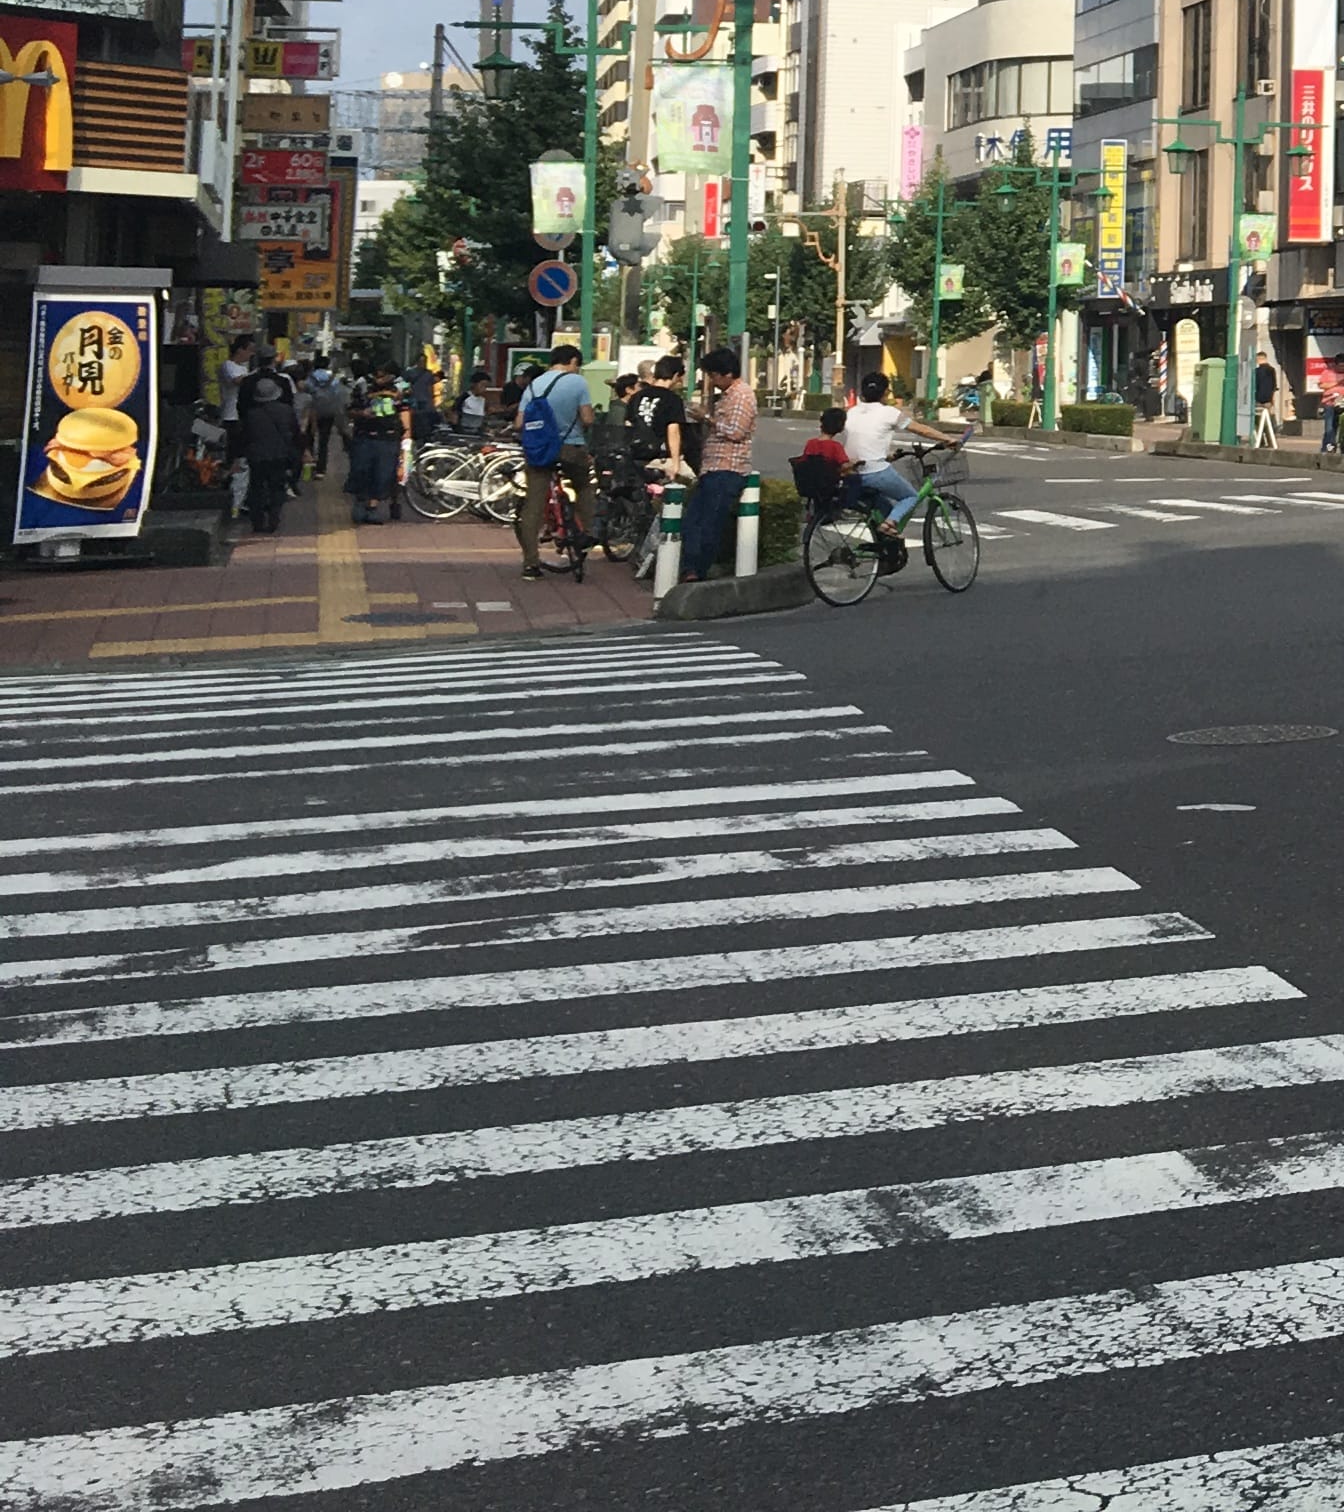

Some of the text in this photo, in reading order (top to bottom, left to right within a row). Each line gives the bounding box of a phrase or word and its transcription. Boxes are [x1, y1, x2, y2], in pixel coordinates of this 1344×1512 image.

[1297, 84, 1316, 191] 三井のリス
[78, 325, 105, 396] 月見
[107, 326, 124, 360] 金の
